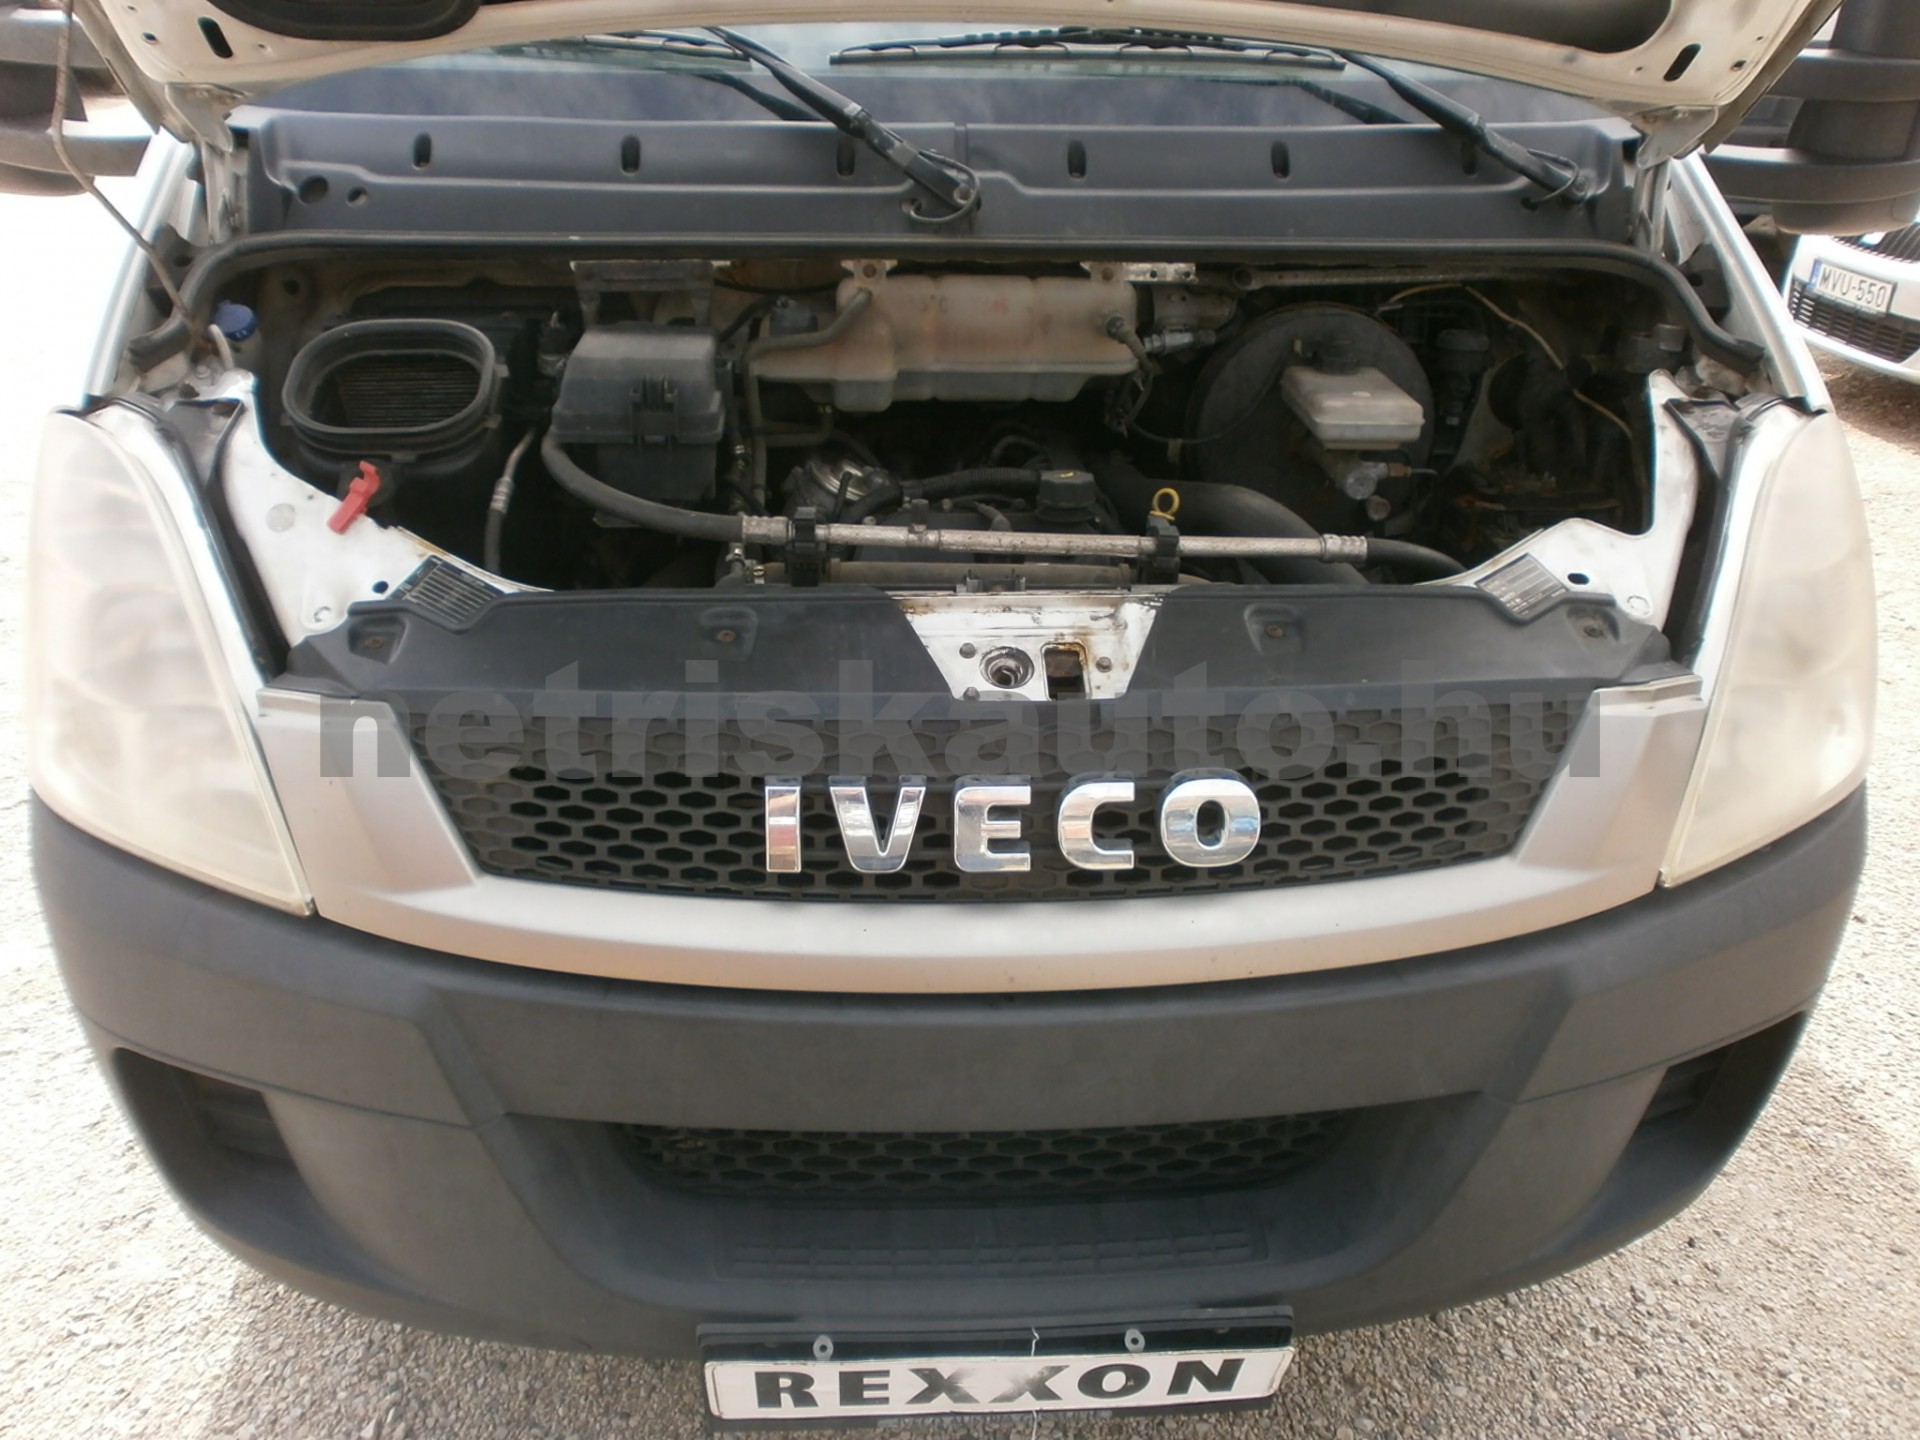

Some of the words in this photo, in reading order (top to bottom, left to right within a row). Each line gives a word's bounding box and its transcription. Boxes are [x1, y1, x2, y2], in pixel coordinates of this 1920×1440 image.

[1819, 266, 1887, 308] MVU-550
[765, 770, 1262, 873] IVECO
[754, 1358, 1246, 1409] REXXON
